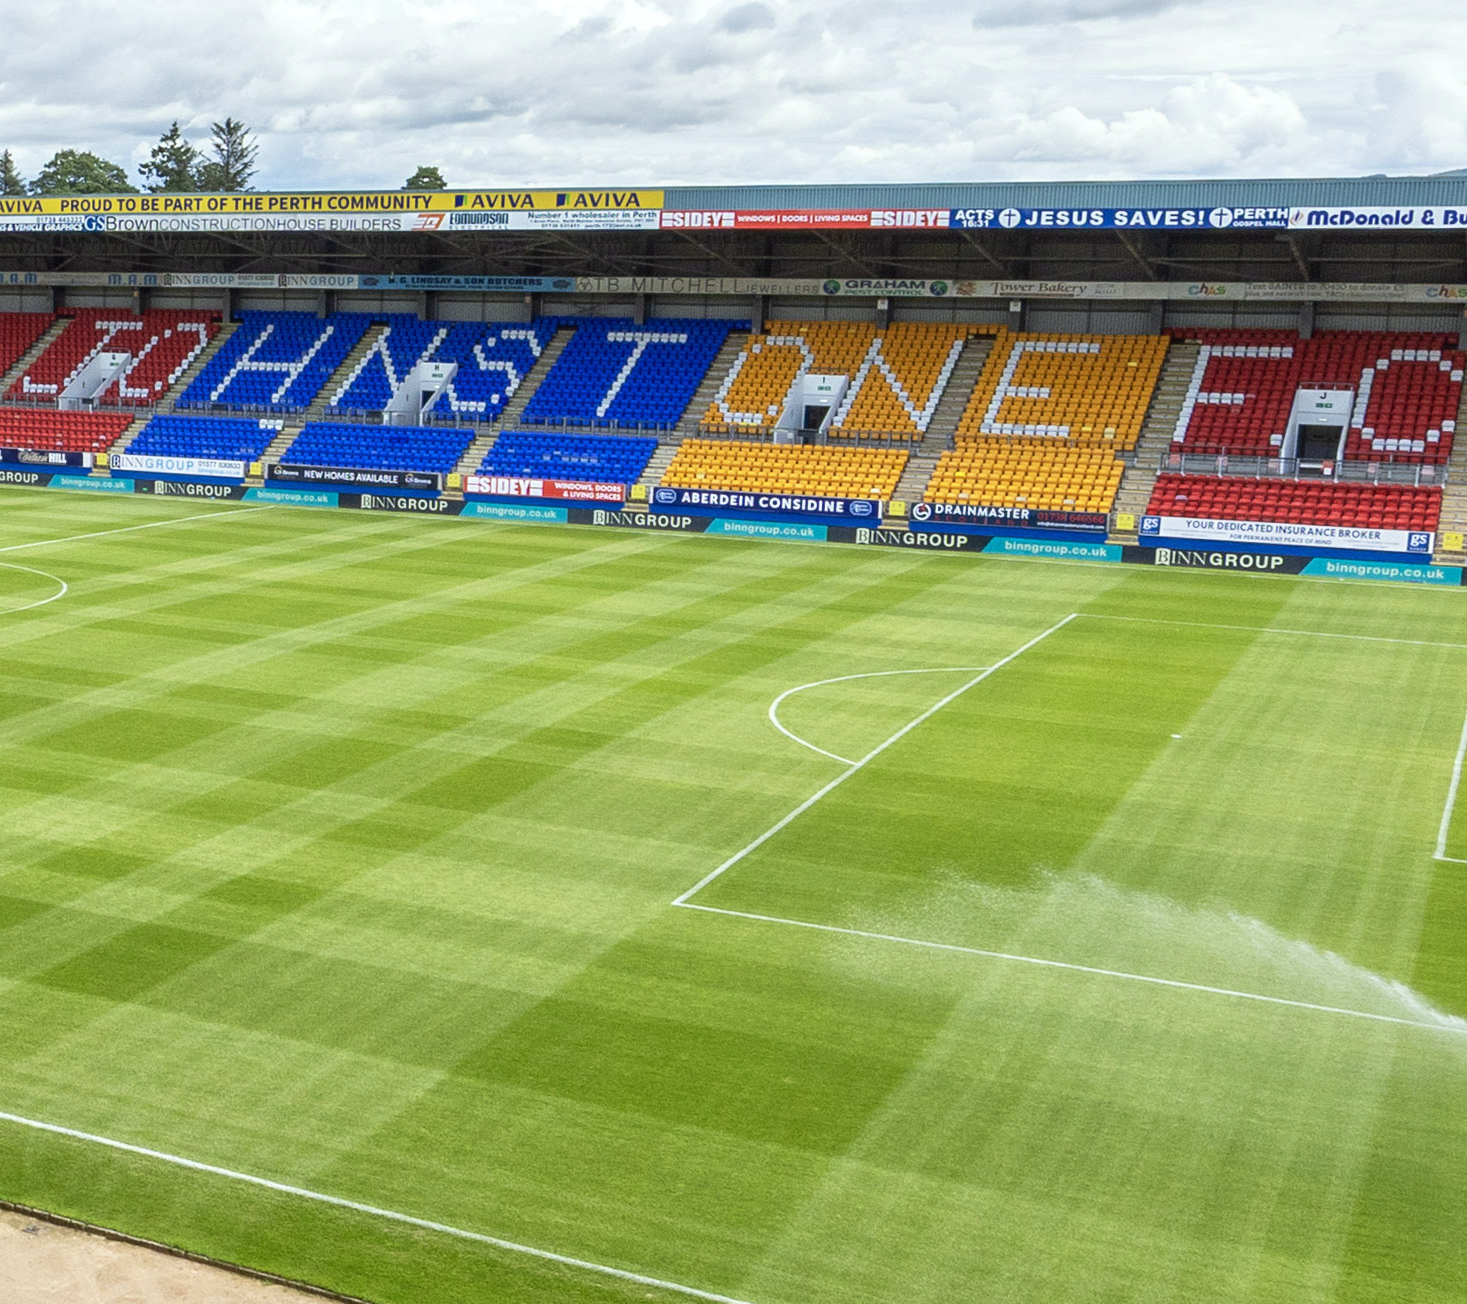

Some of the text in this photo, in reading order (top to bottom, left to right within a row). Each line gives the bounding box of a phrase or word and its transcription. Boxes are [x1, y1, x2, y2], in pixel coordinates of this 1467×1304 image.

[60, 199, 112, 212] PROUD
[117, 199, 136, 211] TO
[141, 198, 159, 210] BE
[164, 198, 202, 210] PART
[207, 198, 227, 210] OF
[232, 197, 263, 210] THE
[268, 196, 322, 210] PERTH
[327, 195, 432, 209] COMMUNITY
[472, 194, 534, 208] AVIVA
[573, 193, 640, 207] AVIVA
[450, 213, 509, 224] EDMUNDSON
[571, 211, 619, 219] wholesaler
[633, 210, 657, 218] Perth
[672, 211, 938, 227] SIDEY WINDOWS DOORS LIVING SPACES SIDEY
[955, 210, 994, 219] ACTS
[1025, 210, 1204, 225] JESUS SAVES!
[1234, 208, 1288, 219] PERTH
[1307, 210, 1414, 226] McDonald
[1421, 209, 1434, 225] &
[330, 218, 401, 230] BUILDERS
[961, 219, 989, 227] 16:31
[631, 278, 819, 293] MITCHELL JEWELLERS
[845, 280, 926, 289] GRAHAM
[990, 282, 1035, 295] Tower
[1039, 282, 1088, 295] Bakery
[48, 452, 67, 464] HILL
[61, 478, 125, 489] binngroup.co.uk
[304, 470, 398, 484] NEW HOMES AVAILABLE
[478, 478, 531, 496] SIDEY
[595, 484, 622, 493] DOORS
[257, 491, 328, 503] binngroup.co.uk
[570, 491, 622, 502] LIVING SPACES
[681, 492, 844, 513] ABERDEIN CONSIDINE
[477, 505, 557, 519] binngroup.co.uk
[935, 504, 1030, 520] DRAINMASTER
[724, 522, 814, 537] binngroup.co.uk
[1186, 519, 1381, 540] YOUR DEDICATED INSURANCE BROKER
[1005, 540, 1107, 557] binngroup.co.uk
[1326, 561, 1444, 580] binngroup.co.uk
